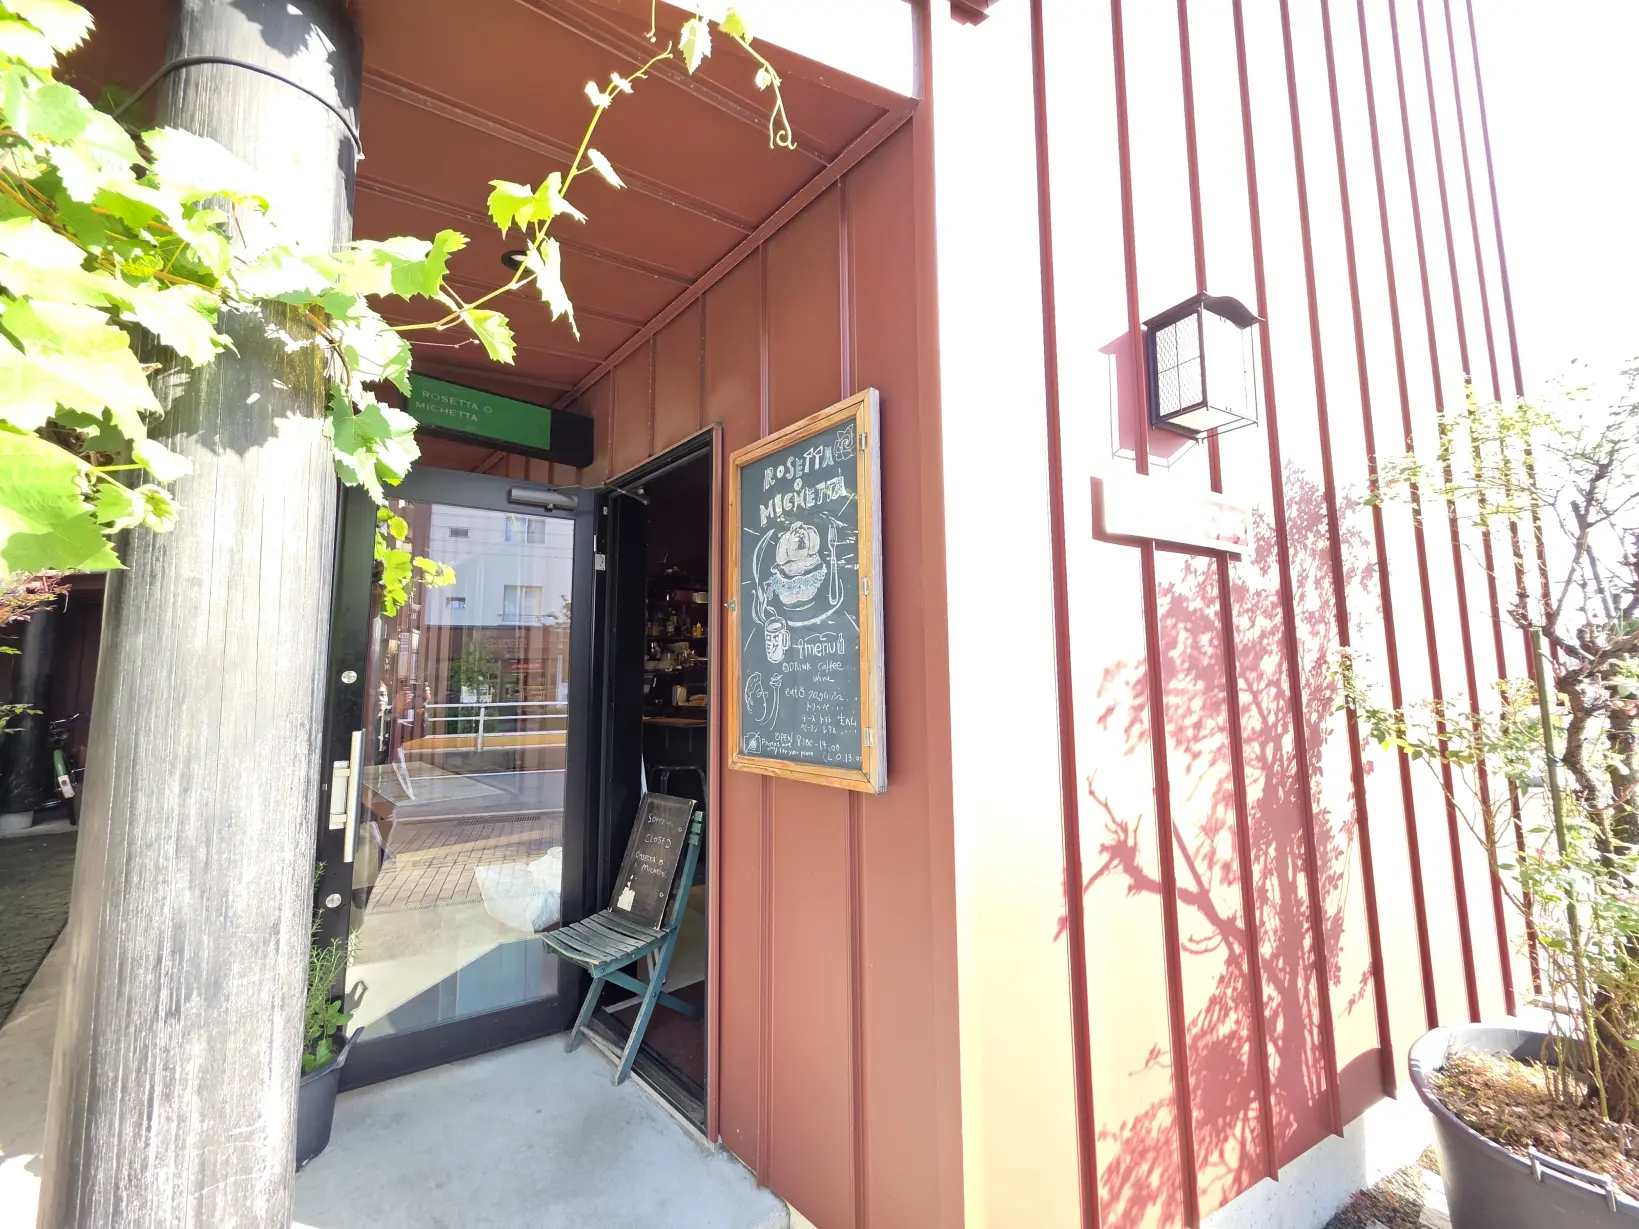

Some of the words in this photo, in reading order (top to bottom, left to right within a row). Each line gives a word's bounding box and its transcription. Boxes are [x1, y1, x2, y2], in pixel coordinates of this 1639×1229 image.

[422, 390, 479, 410] ROSETTA
[483, 405, 493, 414] O
[415, 401, 478, 422] MICHETTA
[763, 445, 834, 492] ROSETTA
[760, 475, 847, 527] MICHETTA
[804, 641, 836, 656] menu
[789, 661, 812, 672] DRINK
[775, 732, 793, 743] OPEN
[644, 833, 672, 849] CLOSED
